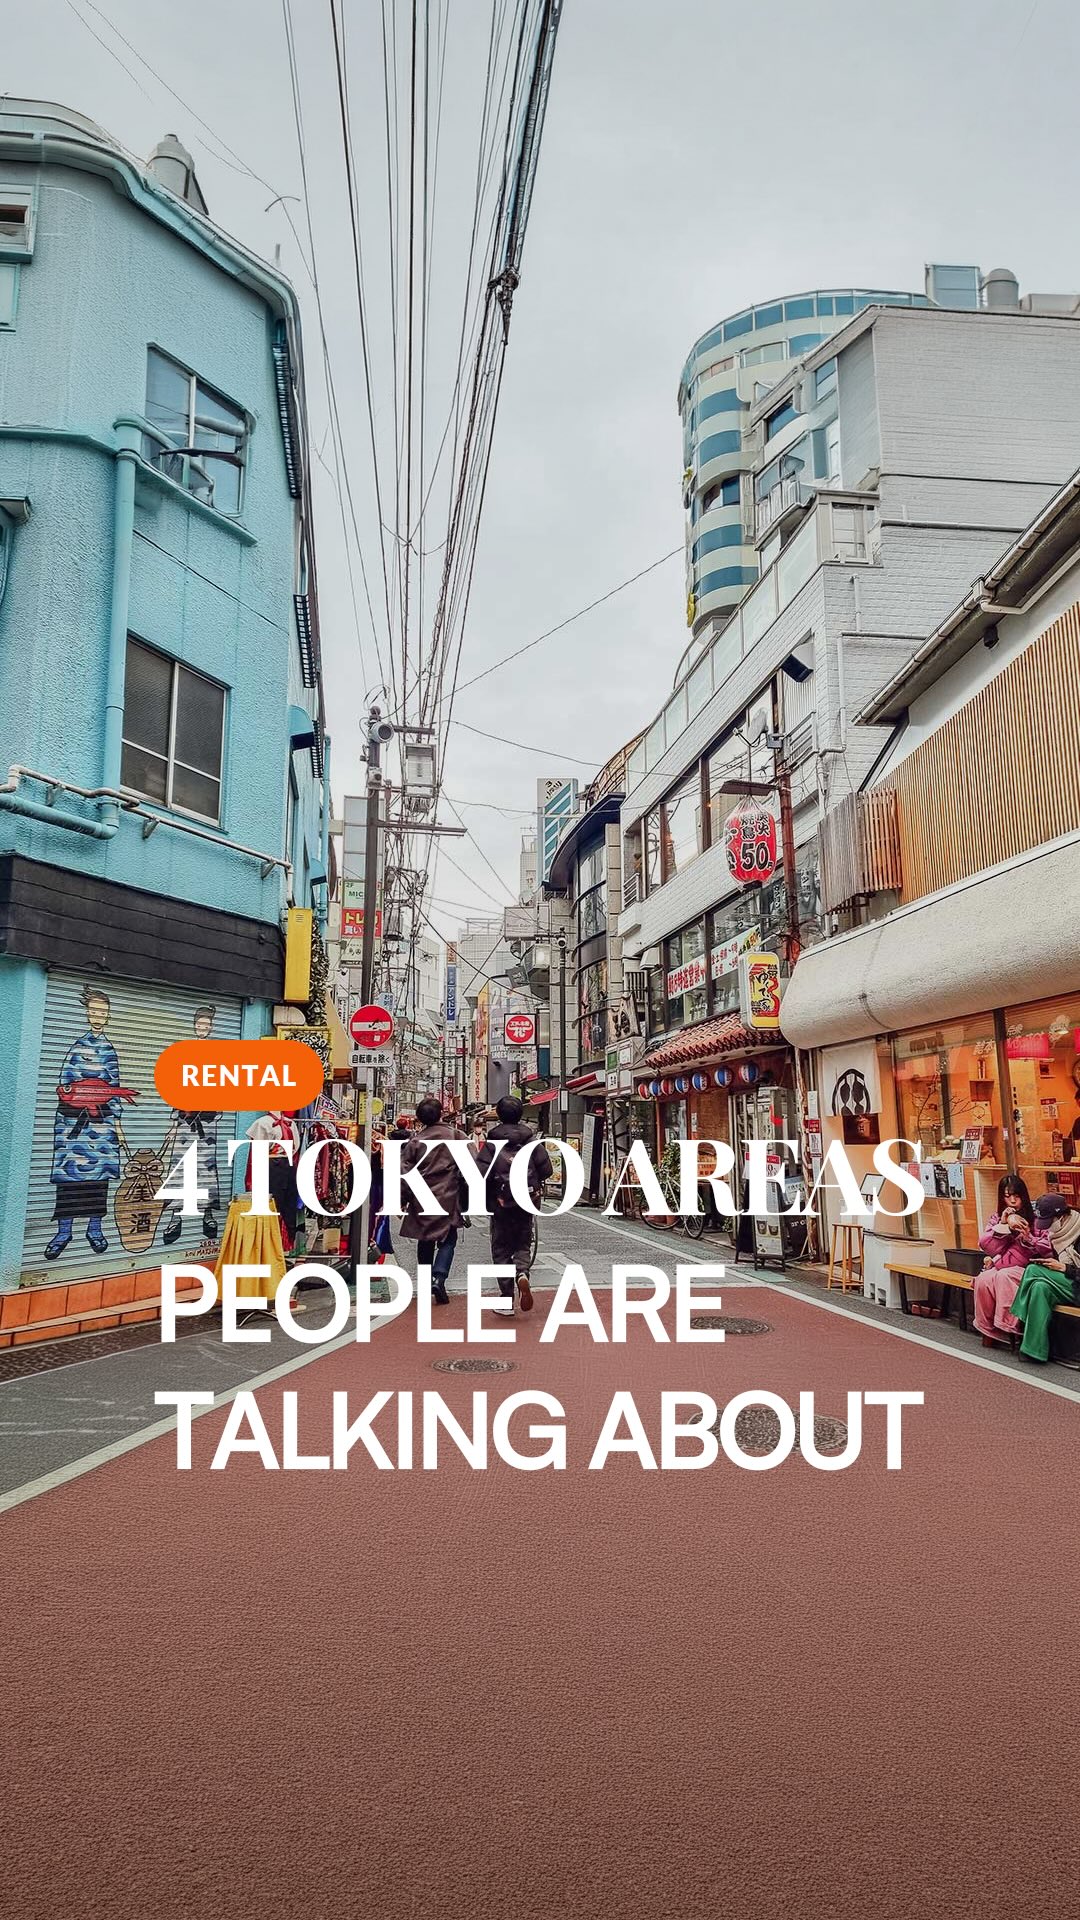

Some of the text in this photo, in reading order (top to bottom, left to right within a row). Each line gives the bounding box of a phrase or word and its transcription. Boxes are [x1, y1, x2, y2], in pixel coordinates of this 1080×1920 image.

[352, 1053, 390, 1064] 自転車を除く
